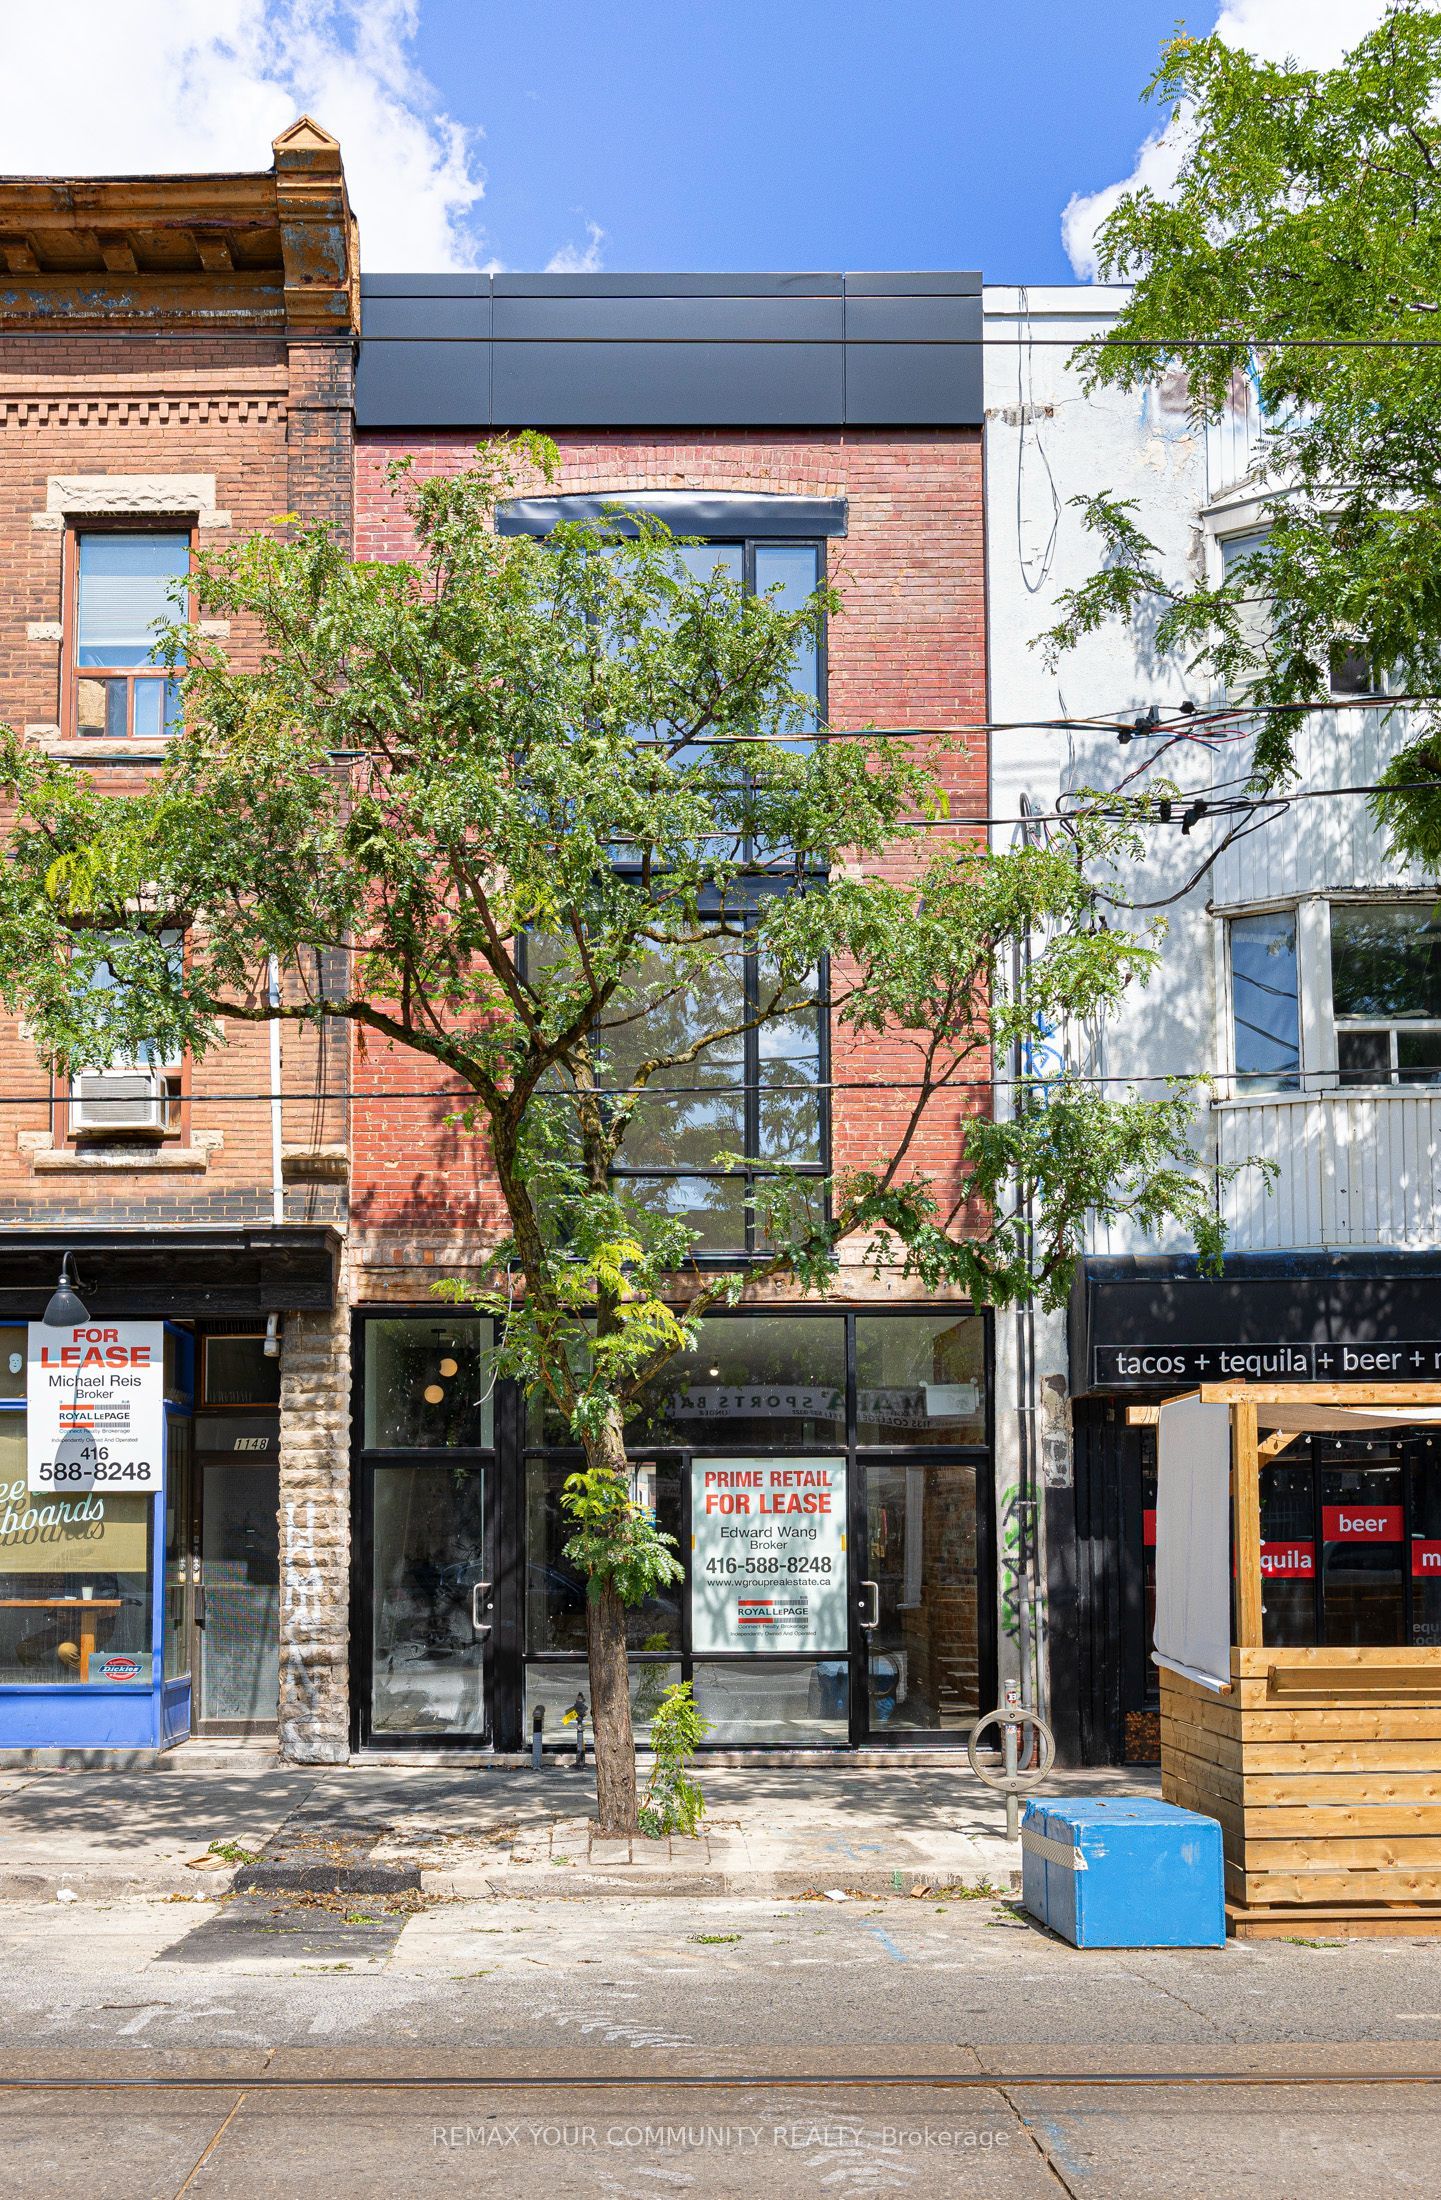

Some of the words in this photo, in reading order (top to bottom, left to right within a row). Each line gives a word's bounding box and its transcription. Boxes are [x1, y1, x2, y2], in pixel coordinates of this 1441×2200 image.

[72, 1328, 119, 1343] FOR
[41, 1346, 151, 1369] LEASE
[1116, 1352, 1186, 1375] tacos
[1219, 1348, 1307, 1377] tequila
[1343, 1347, 1402, 1371] beer
[49, 1374, 104, 1387] Michael
[110, 1374, 142, 1387] Reis
[76, 1389, 114, 1399] Broker
[59, 1412, 92, 1420] ROYAL
[236, 1438, 267, 1450] 1148
[80, 1446, 109, 1461] 416
[39, 1461, 151, 1481] 588-8248
[704, 1471, 764, 1488] PRIME
[769, 1470, 833, 1487] RETAIL
[705, 1493, 751, 1515] FOR
[759, 1492, 832, 1514] LEASE
[1338, 1513, 1388, 1533] beer
[720, 1526, 773, 1538] Edward
[777, 1526, 817, 1541] Wang
[750, 1540, 788, 1550] Broker
[705, 1556, 832, 1574] 416-588-8248
[1260, 1550, 1313, 1573] quila
[707, 1577, 832, 1589] www.wgrouprealestate.ca
[738, 1608, 772, 1616] ROYAL
